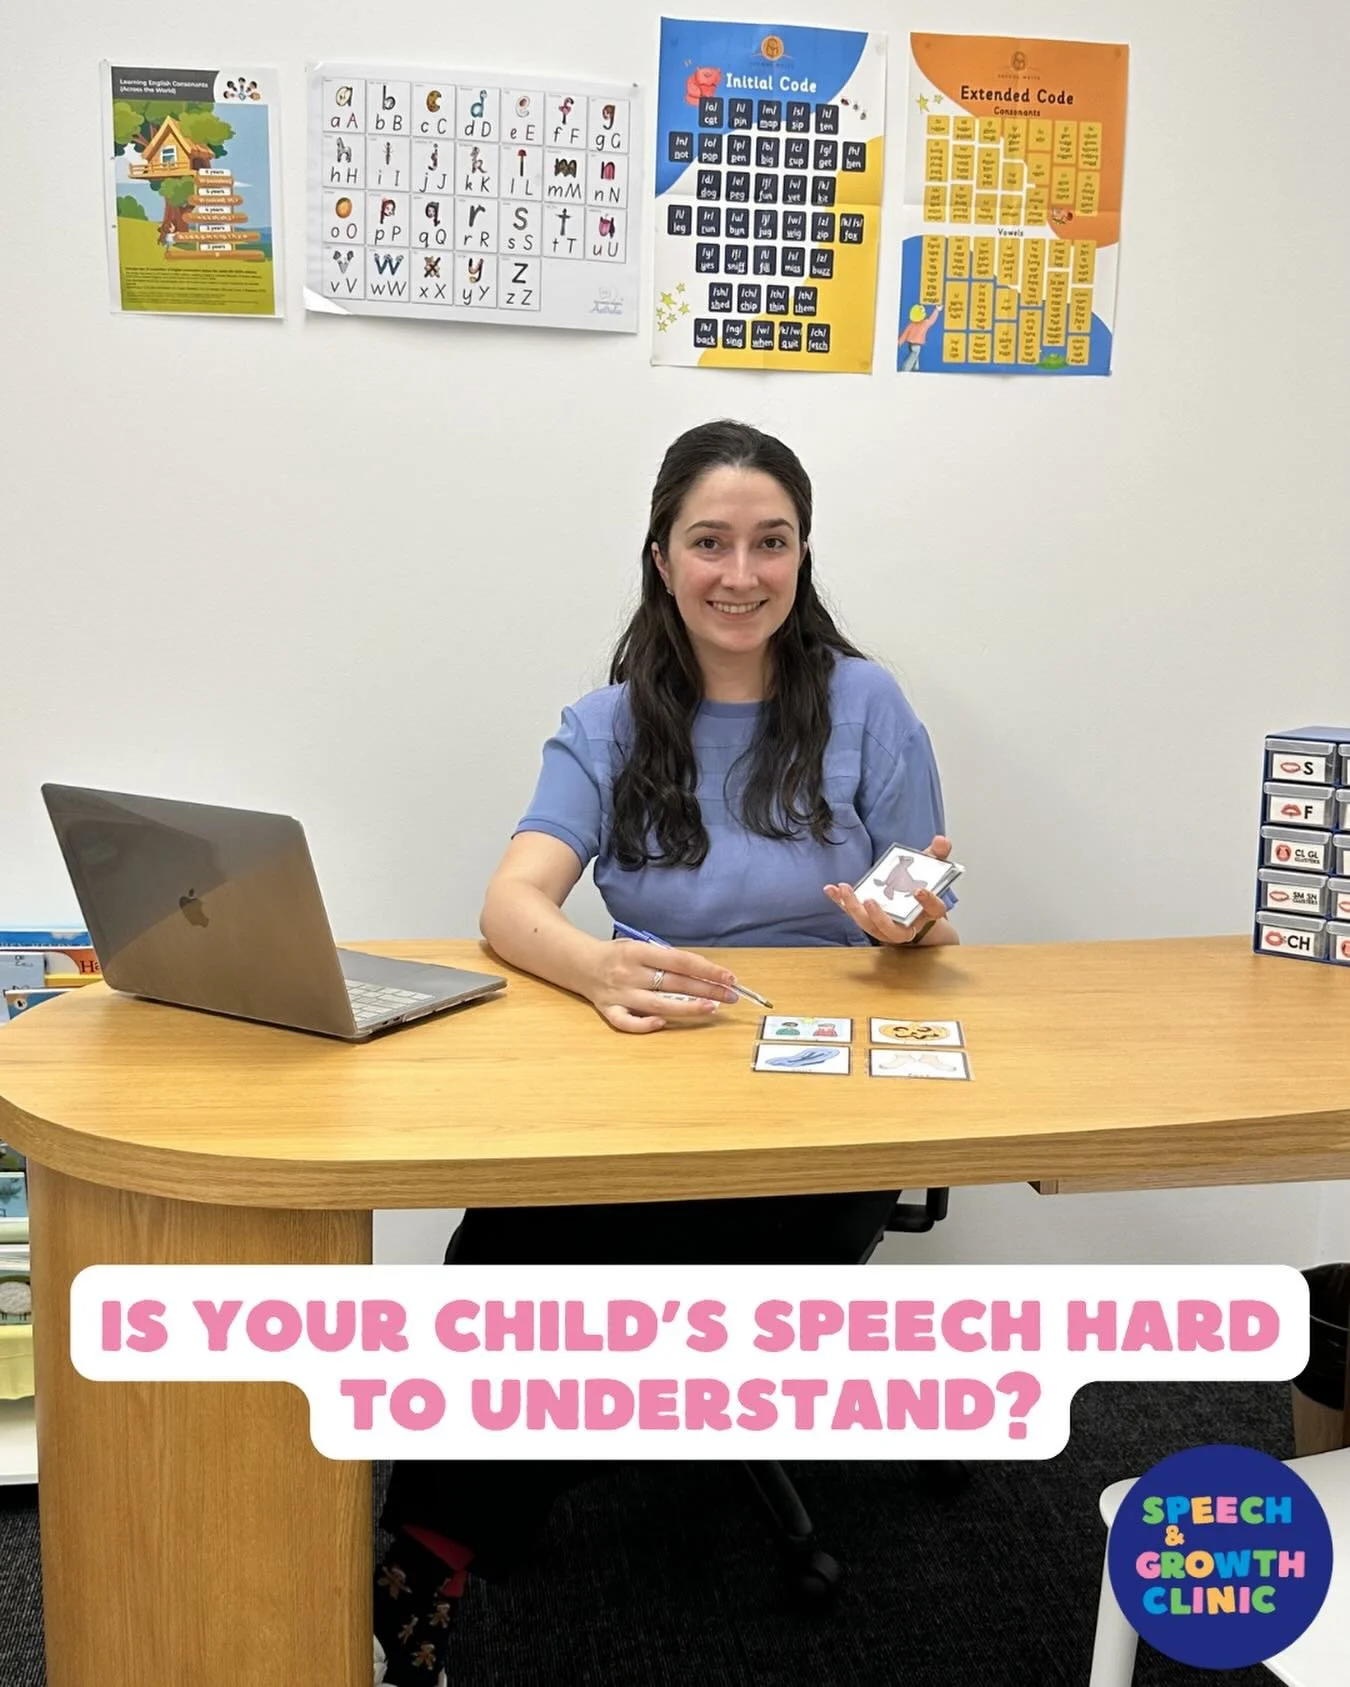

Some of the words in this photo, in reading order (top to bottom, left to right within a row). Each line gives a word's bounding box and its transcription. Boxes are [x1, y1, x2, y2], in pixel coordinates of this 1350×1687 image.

[120, 79, 147, 87] Learning
[149, 80, 171, 88] English
[172, 81, 209, 89] Consonants
[726, 72, 773, 90] Initial
[779, 76, 817, 93] Code
[960, 85, 1030, 103] Extended
[1037, 89, 1074, 105] Code
[993, 106, 1041, 117] Consonants
[704, 116, 717, 125] cat
[734, 117, 747, 127] pin
[760, 120, 778, 128] map
[792, 120, 804, 130] sip
[820, 122, 833, 132] ten
[674, 151, 688, 159] not
[702, 153, 718, 162] pop
[731, 155, 746, 163] pen
[761, 154, 774, 166] big
[789, 158, 804, 167] cup
[819, 159, 832, 169] get
[846, 158, 861, 169] hen
[700, 187, 717, 198] dog
[730, 191, 745, 200] peg
[758, 190, 772, 202] fun
[787, 194, 800, 203] vet
[674, 222, 686, 233] leg
[701, 226, 716, 234] run
[730, 225, 745, 236] bun
[758, 227, 772, 238] jug
[787, 229, 801, 240] wig
[817, 231, 829, 240] zip
[844, 230, 857, 241] fox
[998, 228, 1024, 238] Vowels
[701, 263, 714, 271] yes
[812, 266, 830, 276] buzz
[711, 300, 730, 309] shed
[740, 301, 758, 312] chip
[769, 302, 785, 312] thin
[795, 303, 815, 313] them
[696, 335, 716, 345] back
[726, 337, 743, 348] sing
[753, 338, 773, 348] when
[809, 340, 830, 352] fetch
[1303, 762, 1314, 776] S
[1304, 806, 1313, 820] F
[1295, 849, 1305, 858] CL
[1287, 935, 1310, 951] CH
